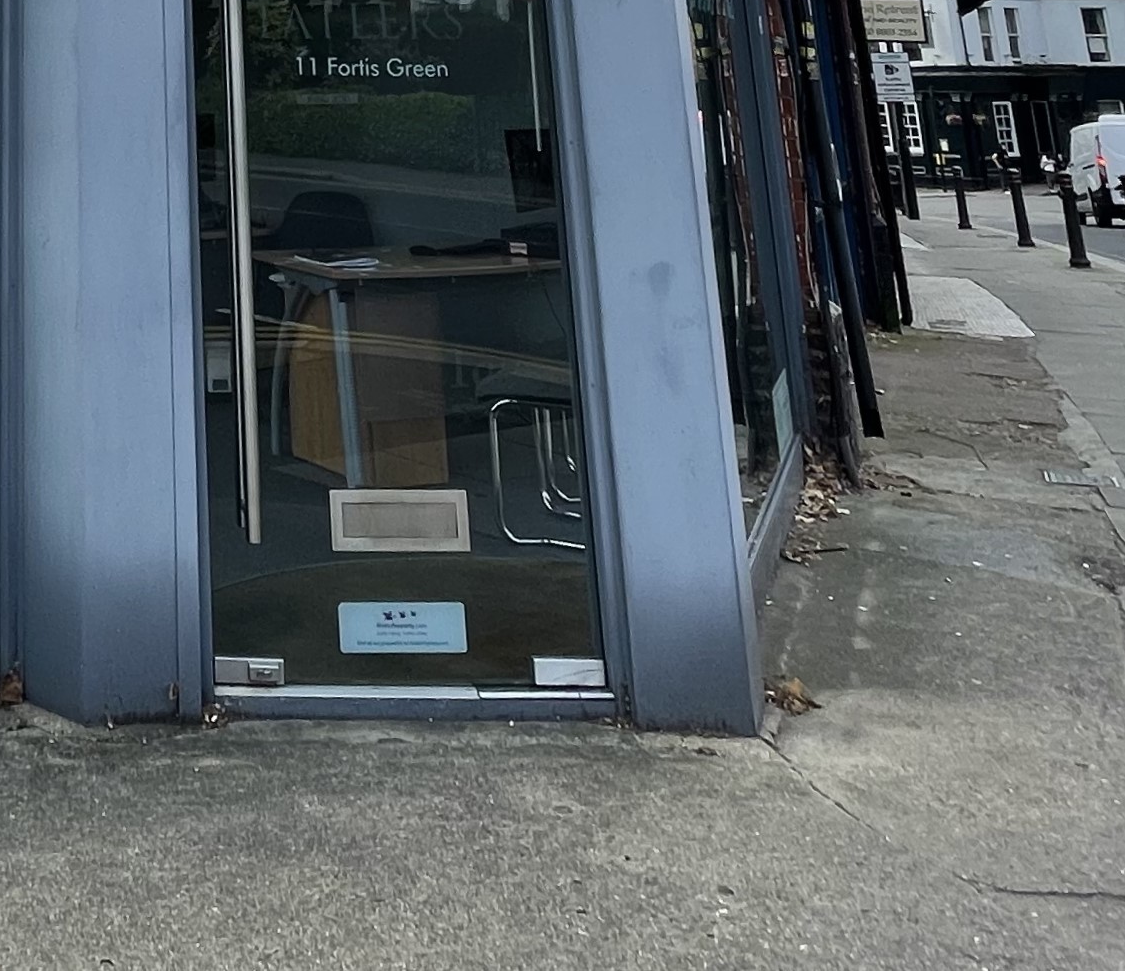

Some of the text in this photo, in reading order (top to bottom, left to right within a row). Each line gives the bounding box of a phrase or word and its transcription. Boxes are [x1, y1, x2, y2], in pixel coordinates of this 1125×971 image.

[295, 56, 449, 77] 11 Fortis Green
